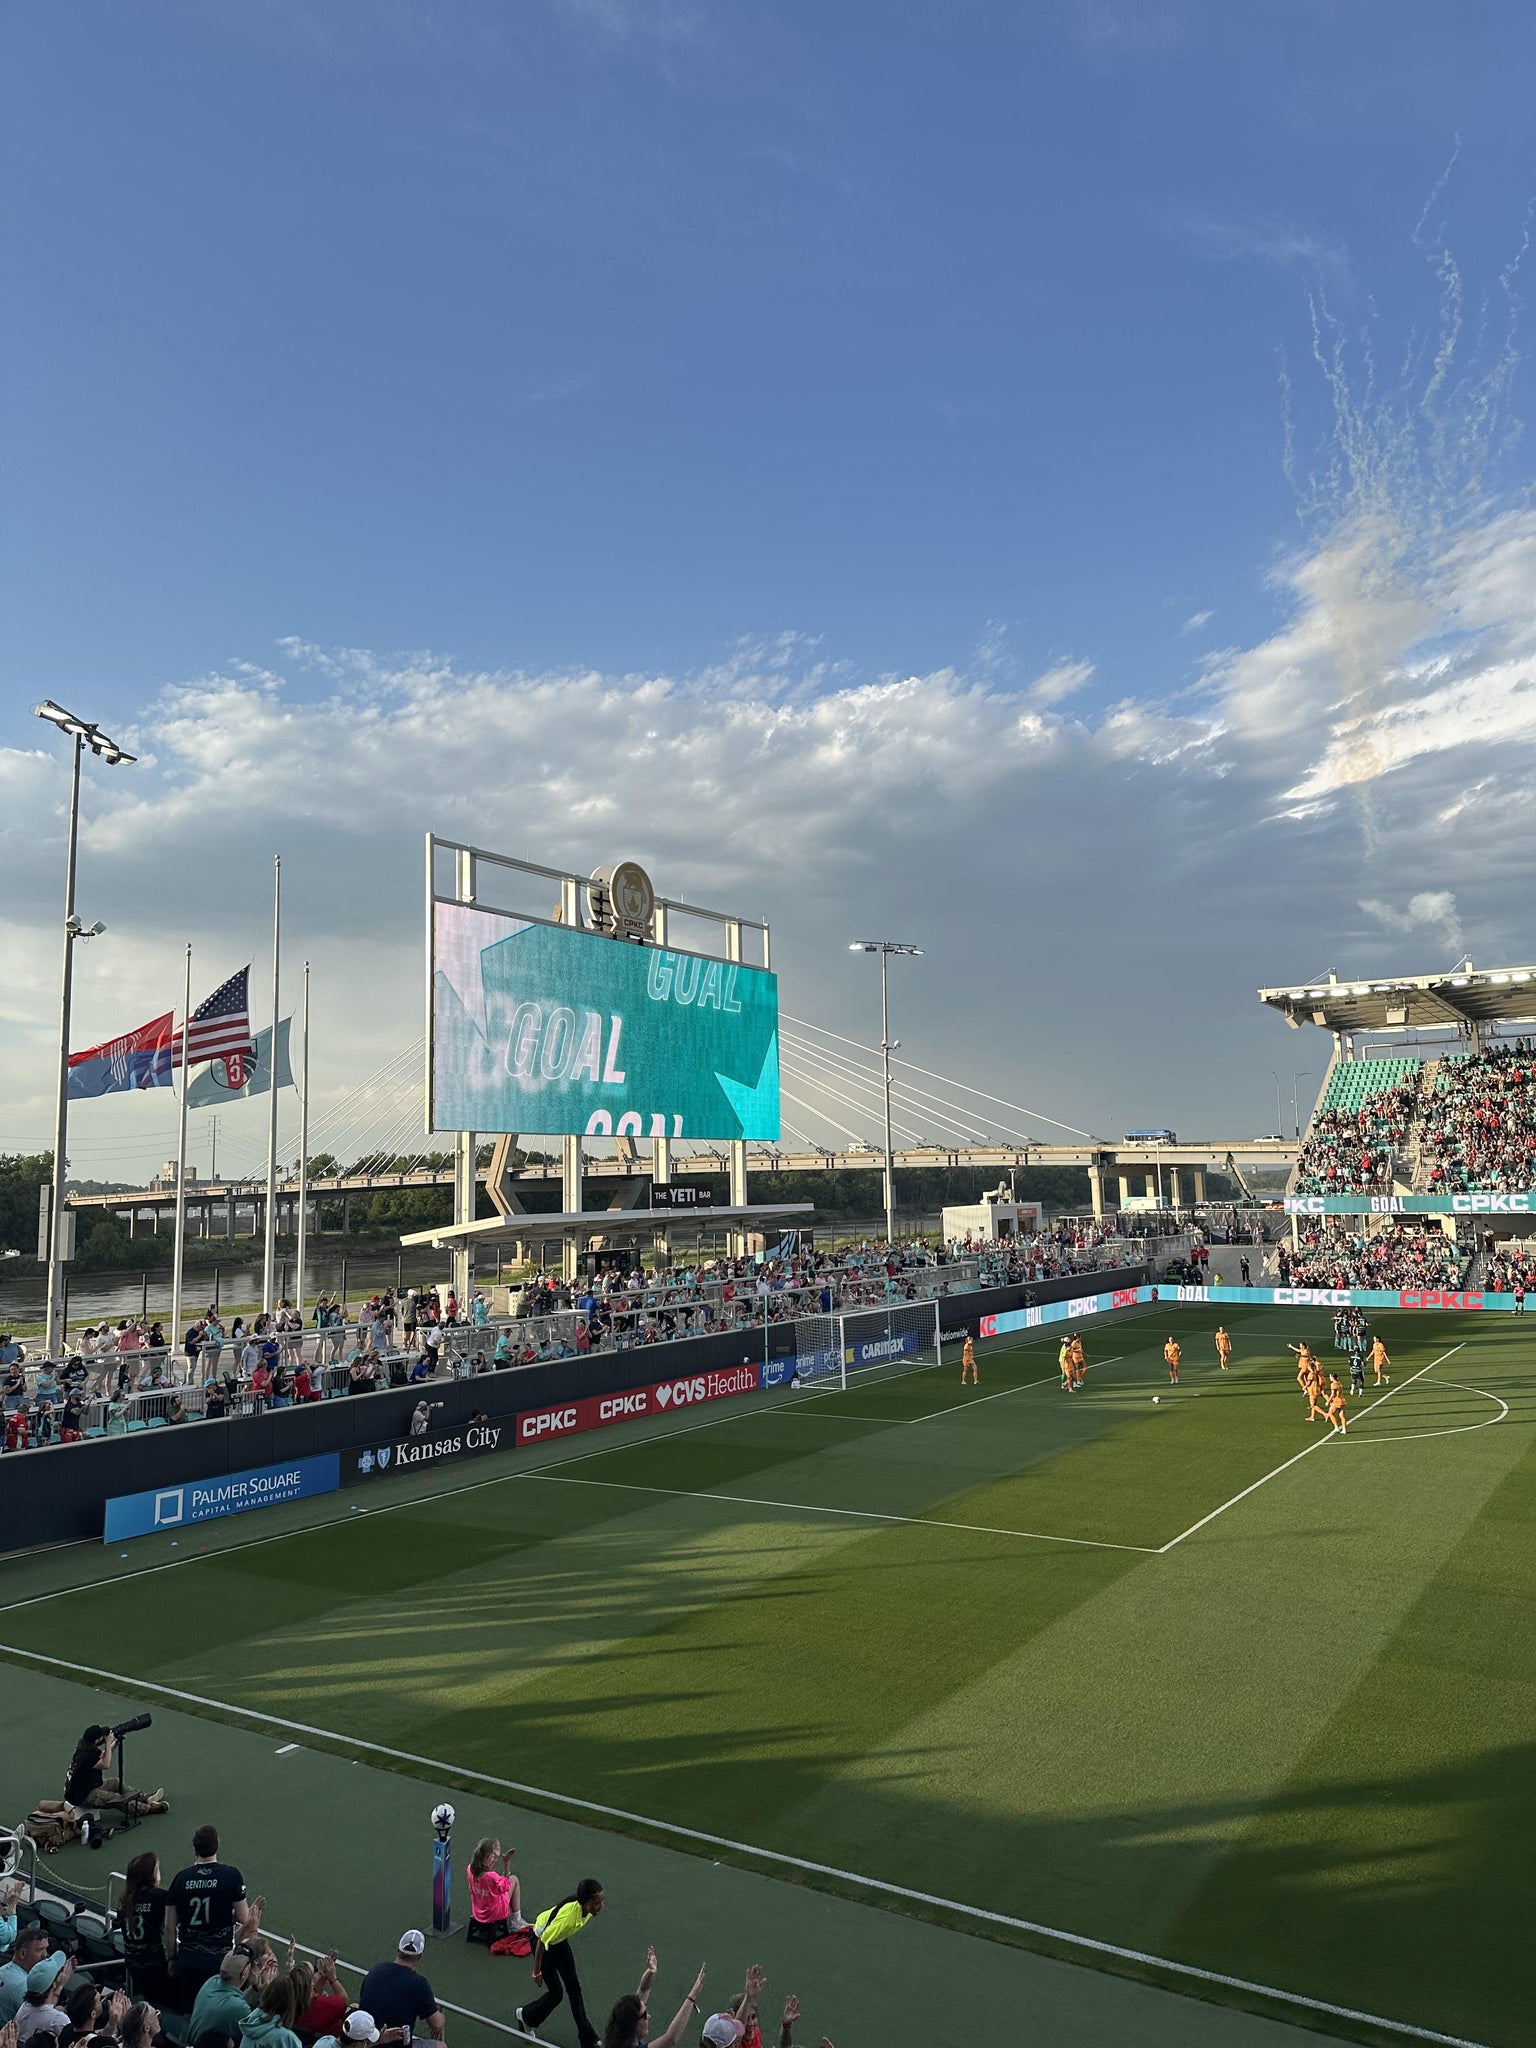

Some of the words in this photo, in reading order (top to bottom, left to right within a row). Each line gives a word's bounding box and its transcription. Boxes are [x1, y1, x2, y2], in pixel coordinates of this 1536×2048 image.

[624, 919, 644, 930] CPKC
[505, 1002, 626, 1084] GOAL
[654, 1191, 667, 1200] THE
[669, 1188, 696, 1202] YETI
[698, 1190, 711, 1199] BAR
[1370, 1197, 1406, 1212] GOAL
[1452, 1194, 1529, 1211] CPKC
[1112, 1287, 1138, 1309] CPKC
[1177, 1285, 1210, 1301] GOAL
[1273, 1289, 1351, 1305] CPKC
[1400, 1291, 1483, 1309] CPKC
[1026, 1306, 1042, 1327] GOAL
[1066, 1295, 1097, 1318] CPKC
[763, 1360, 785, 1379] prime
[672, 1377, 706, 1405] CVS
[707, 1367, 755, 1397] Health
[600, 1392, 647, 1420] CPKC
[522, 1408, 577, 1437] CPKC
[394, 1436, 461, 1466] Kansas
[466, 1426, 502, 1449] City
[192, 1484, 248, 1507] PALMER
[249, 1471, 301, 1493] SQUARE
[192, 1504, 231, 1519] CAPITAL
[236, 1489, 299, 1508] MANAGEMENT
[185, 1879, 218, 1890] SENTNOR
[189, 1896, 211, 1926] 21
